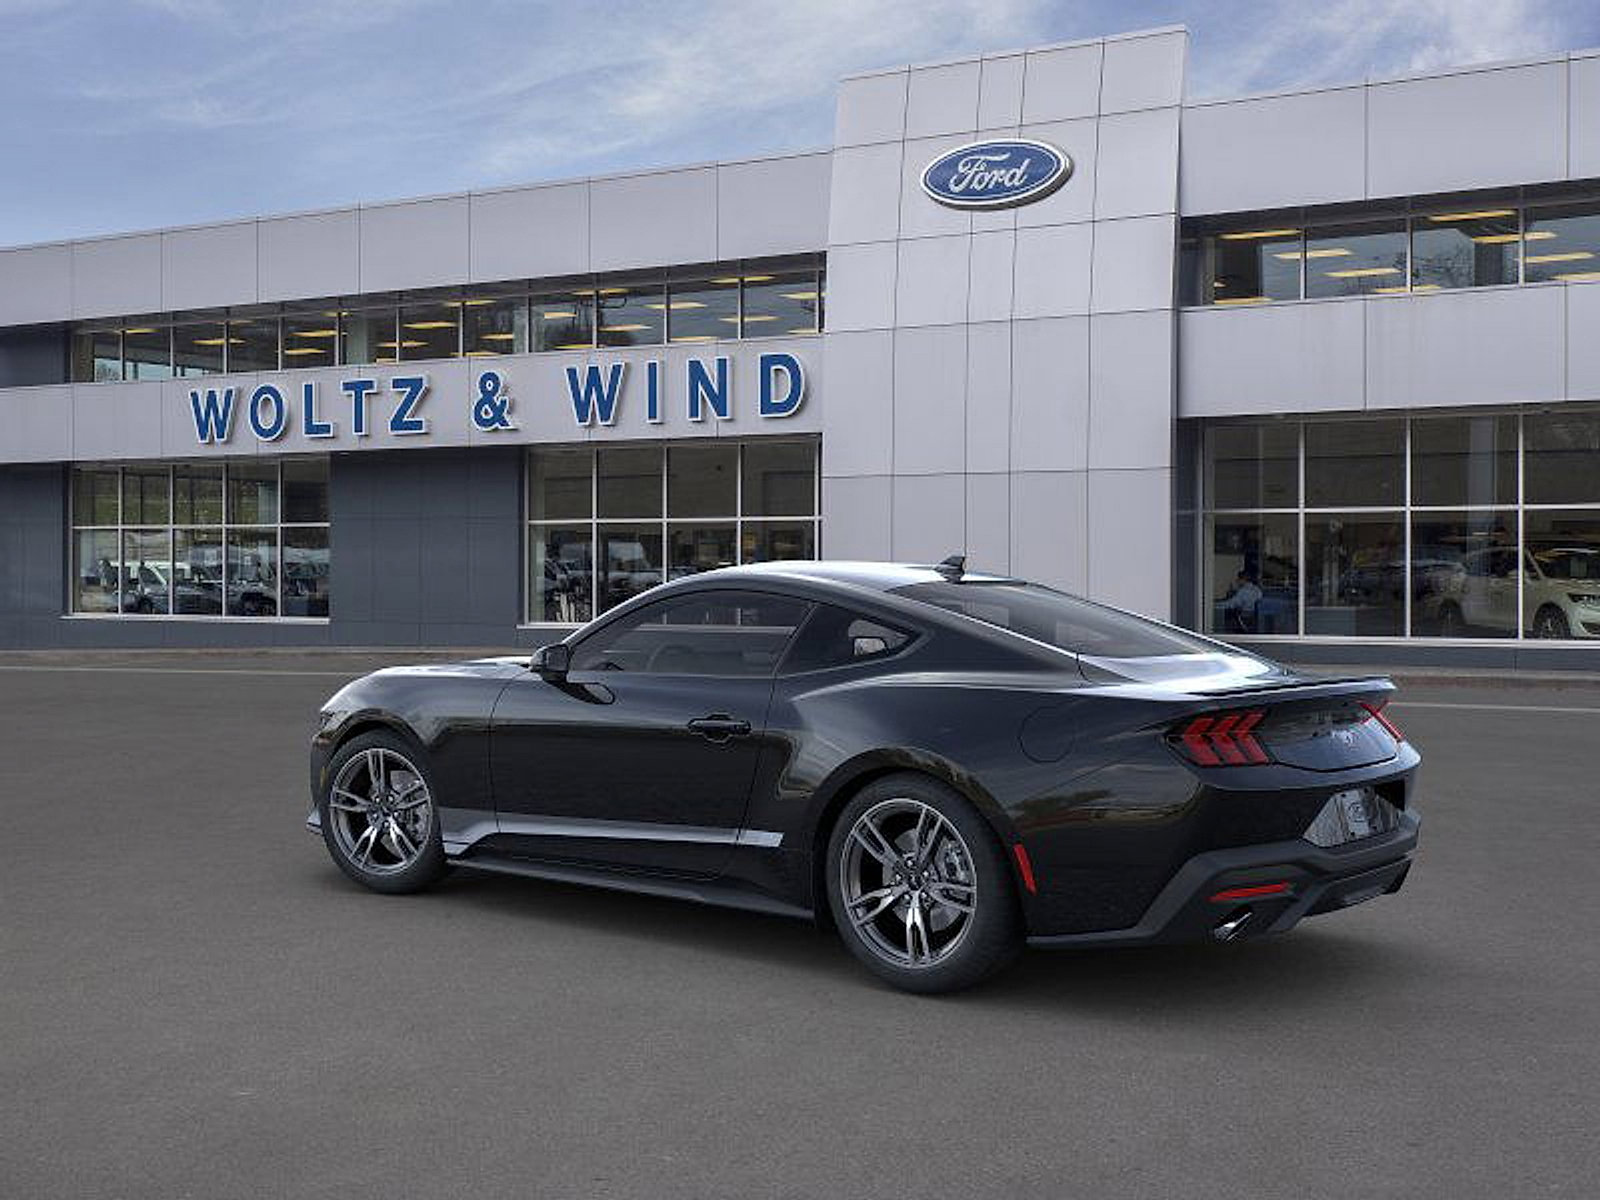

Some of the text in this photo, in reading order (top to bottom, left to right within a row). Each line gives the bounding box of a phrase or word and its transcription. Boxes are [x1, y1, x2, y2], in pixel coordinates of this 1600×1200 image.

[949, 152, 1031, 193] Ford
[189, 351, 807, 443] WOLTZ & WIND
